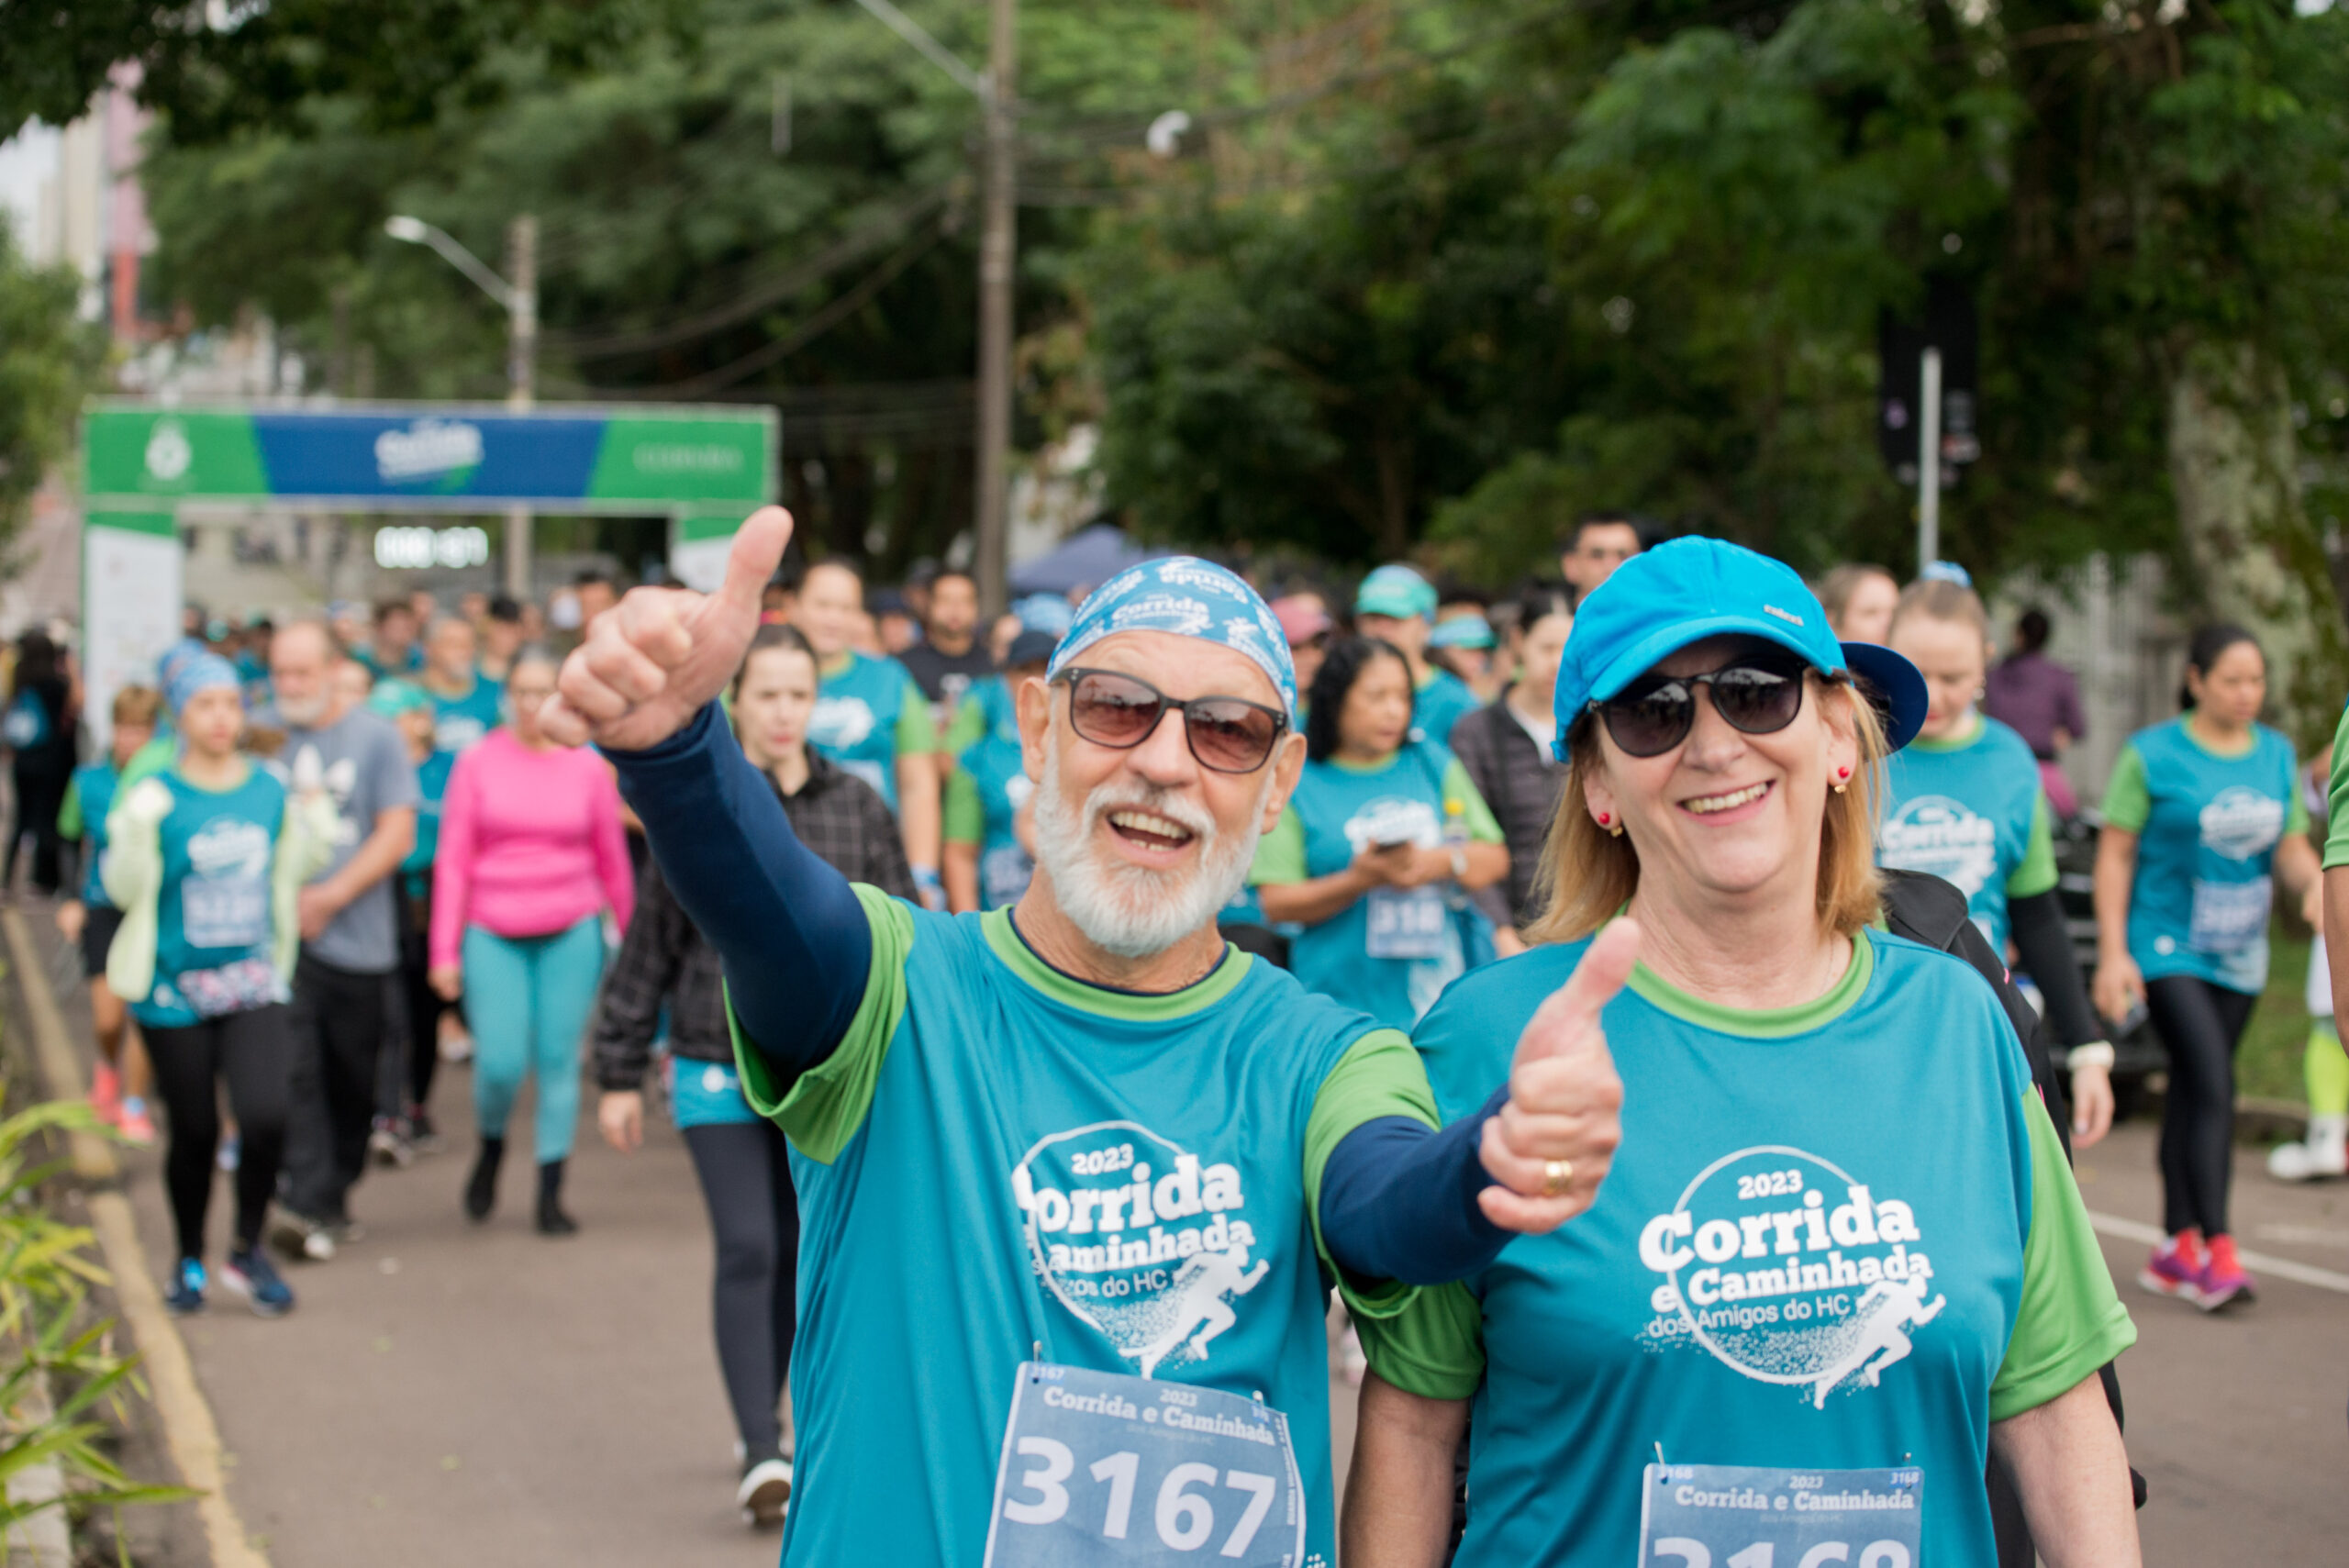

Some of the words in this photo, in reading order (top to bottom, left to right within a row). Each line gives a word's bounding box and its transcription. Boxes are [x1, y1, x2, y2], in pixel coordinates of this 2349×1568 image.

[1071, 1143, 1135, 1175] 2023
[1737, 1168, 1803, 1200] 2023
[1049, 1213, 1256, 1273] aminhada
[1639, 1185, 1920, 1273] Corrida
[1101, 1275, 1130, 1298] do
[1133, 1269, 1168, 1295] HC
[1651, 1284, 1677, 1313] e
[1688, 1245, 1934, 1306] Caminhada
[1648, 1315, 1692, 1338] dos
[1698, 1304, 1779, 1330] Amigos
[1783, 1297, 1811, 1325] do
[1816, 1294, 1851, 1318] HC
[1043, 1386, 1138, 1420] Corrida
[1142, 1406, 1159, 1423] e
[1163, 1407, 1276, 1446] Caminhada
[1159, 1388, 1198, 1407] 2023
[1003, 1436, 1277, 1559] 3167
[1675, 1485, 1769, 1511] Corrida
[1774, 1495, 1789, 1511] e
[1794, 1488, 1915, 1511] Caminhada
[1788, 1475, 1824, 1490] 2023
